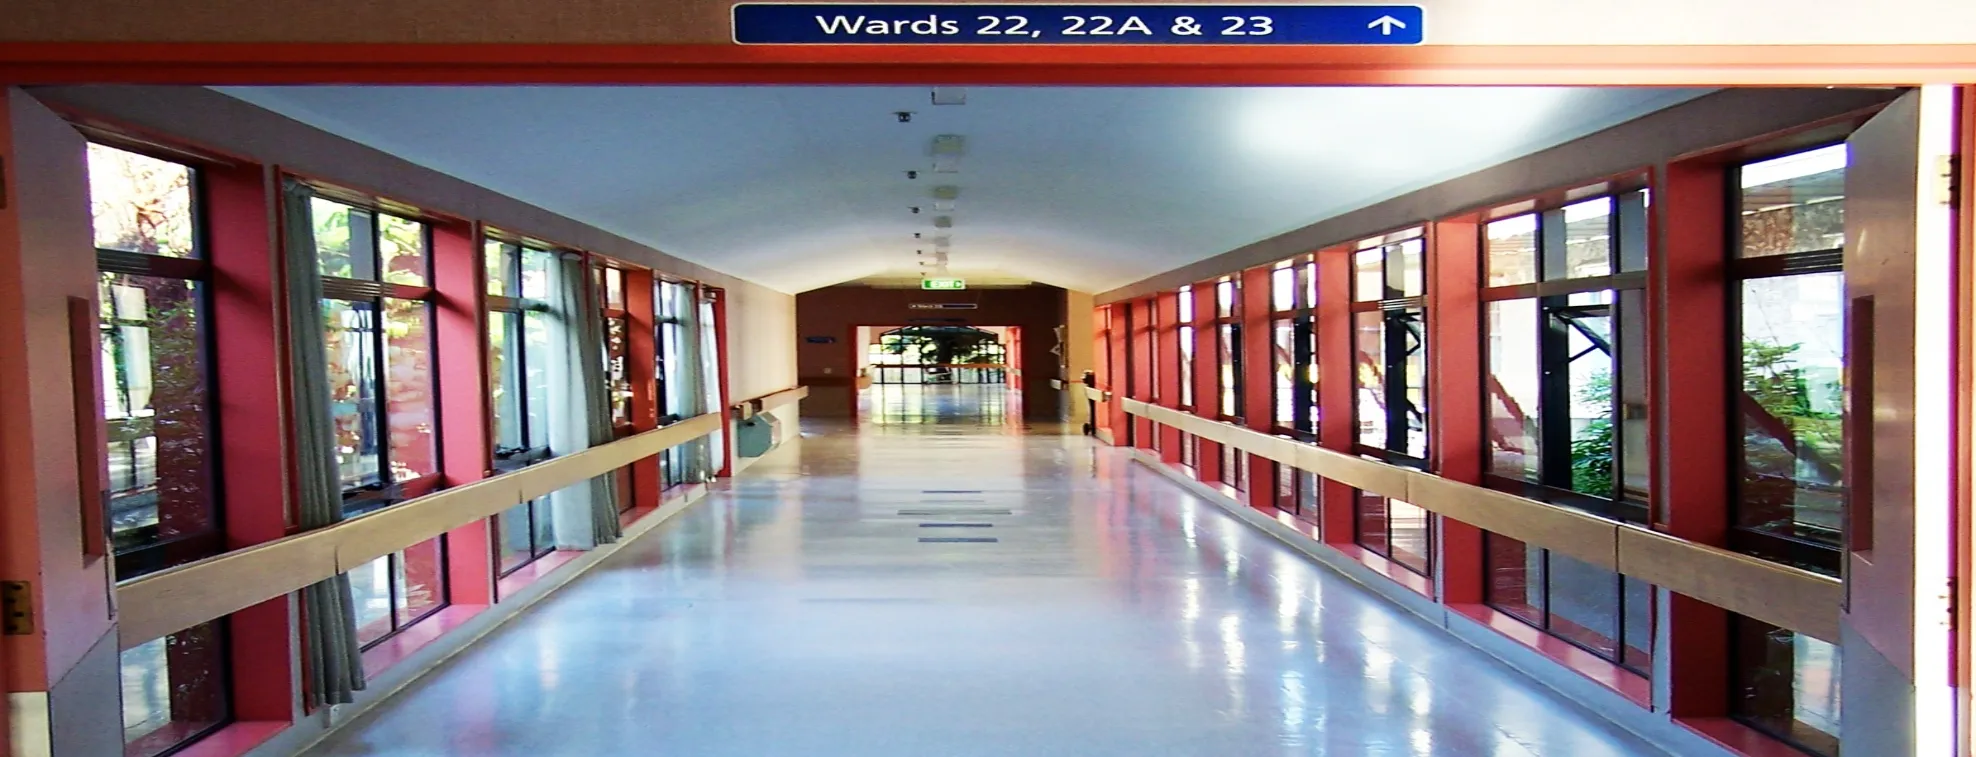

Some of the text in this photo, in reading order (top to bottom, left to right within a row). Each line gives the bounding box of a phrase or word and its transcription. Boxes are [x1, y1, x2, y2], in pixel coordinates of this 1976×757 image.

[816, 14, 1274, 38] Wards 22, 22A & 23
[930, 280, 954, 289] EXIT
